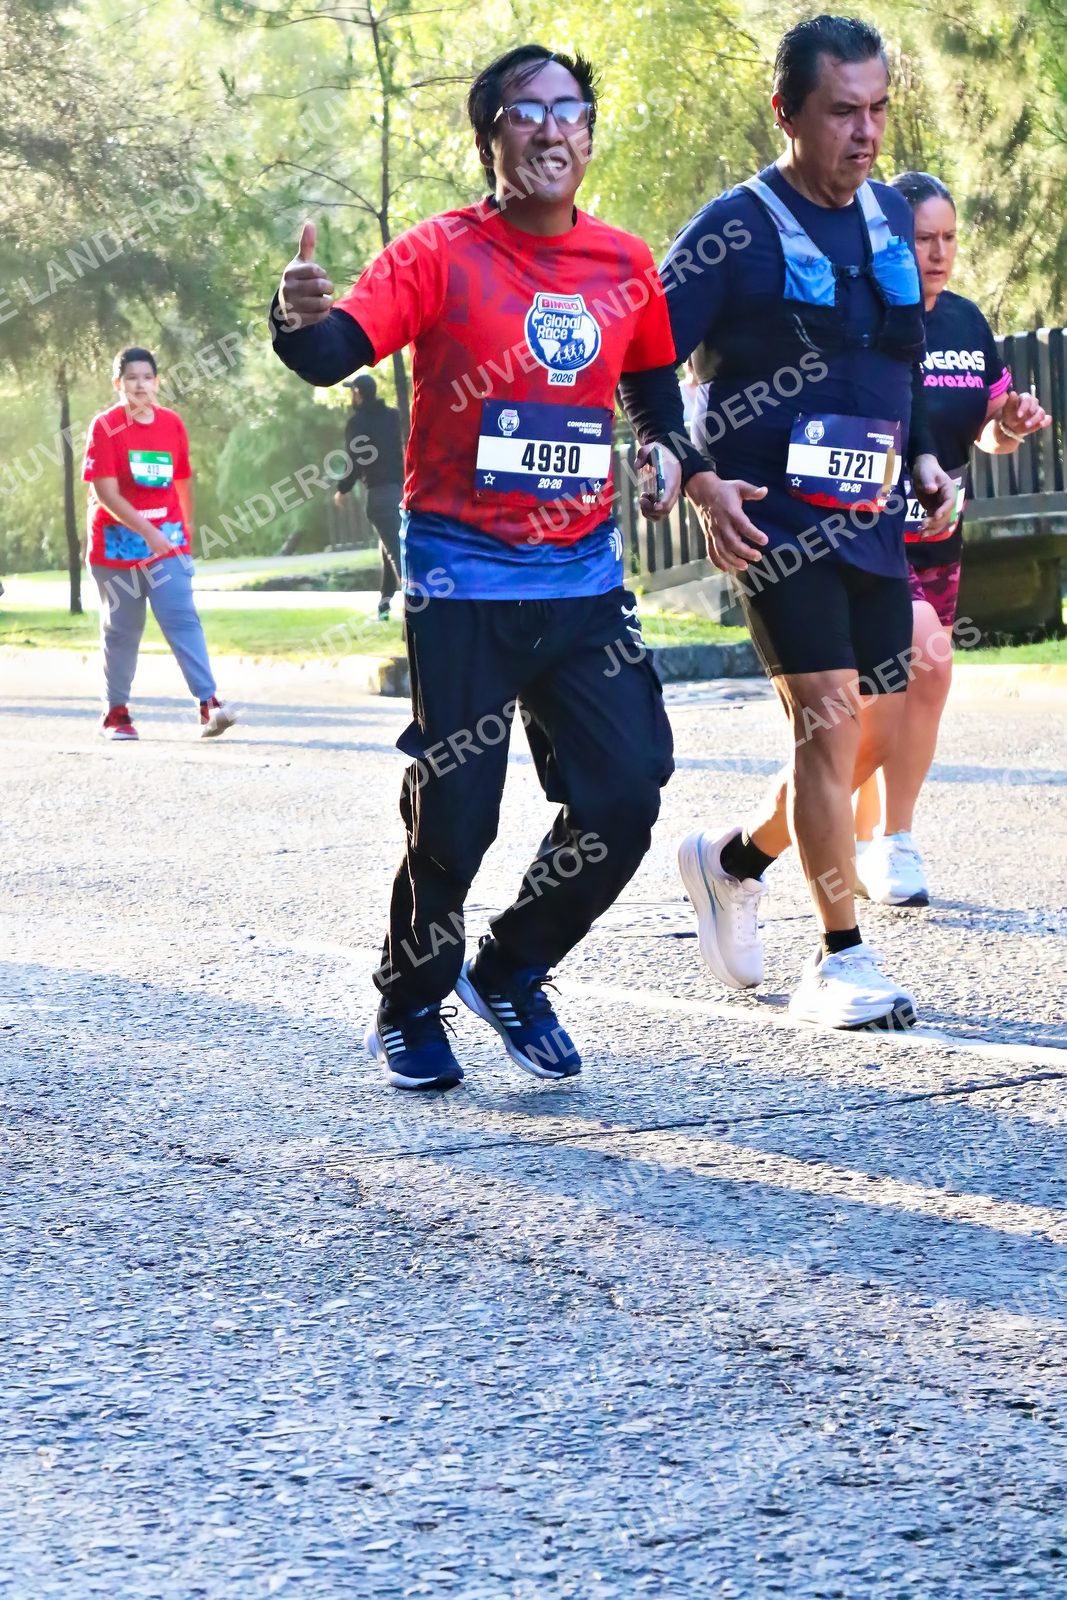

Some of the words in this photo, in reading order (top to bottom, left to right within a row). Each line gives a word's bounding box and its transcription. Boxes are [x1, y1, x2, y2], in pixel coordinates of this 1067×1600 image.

[542, 299, 580, 310] BIMBO
[544, 314, 581, 330] Global
[536, 325, 568, 340] Race
[550, 372, 574, 384] 2026
[924, 372, 984, 388] orazón
[522, 442, 580, 474] 4930
[828, 450, 874, 480] 5721
[582, 494, 596, 504] 10K
